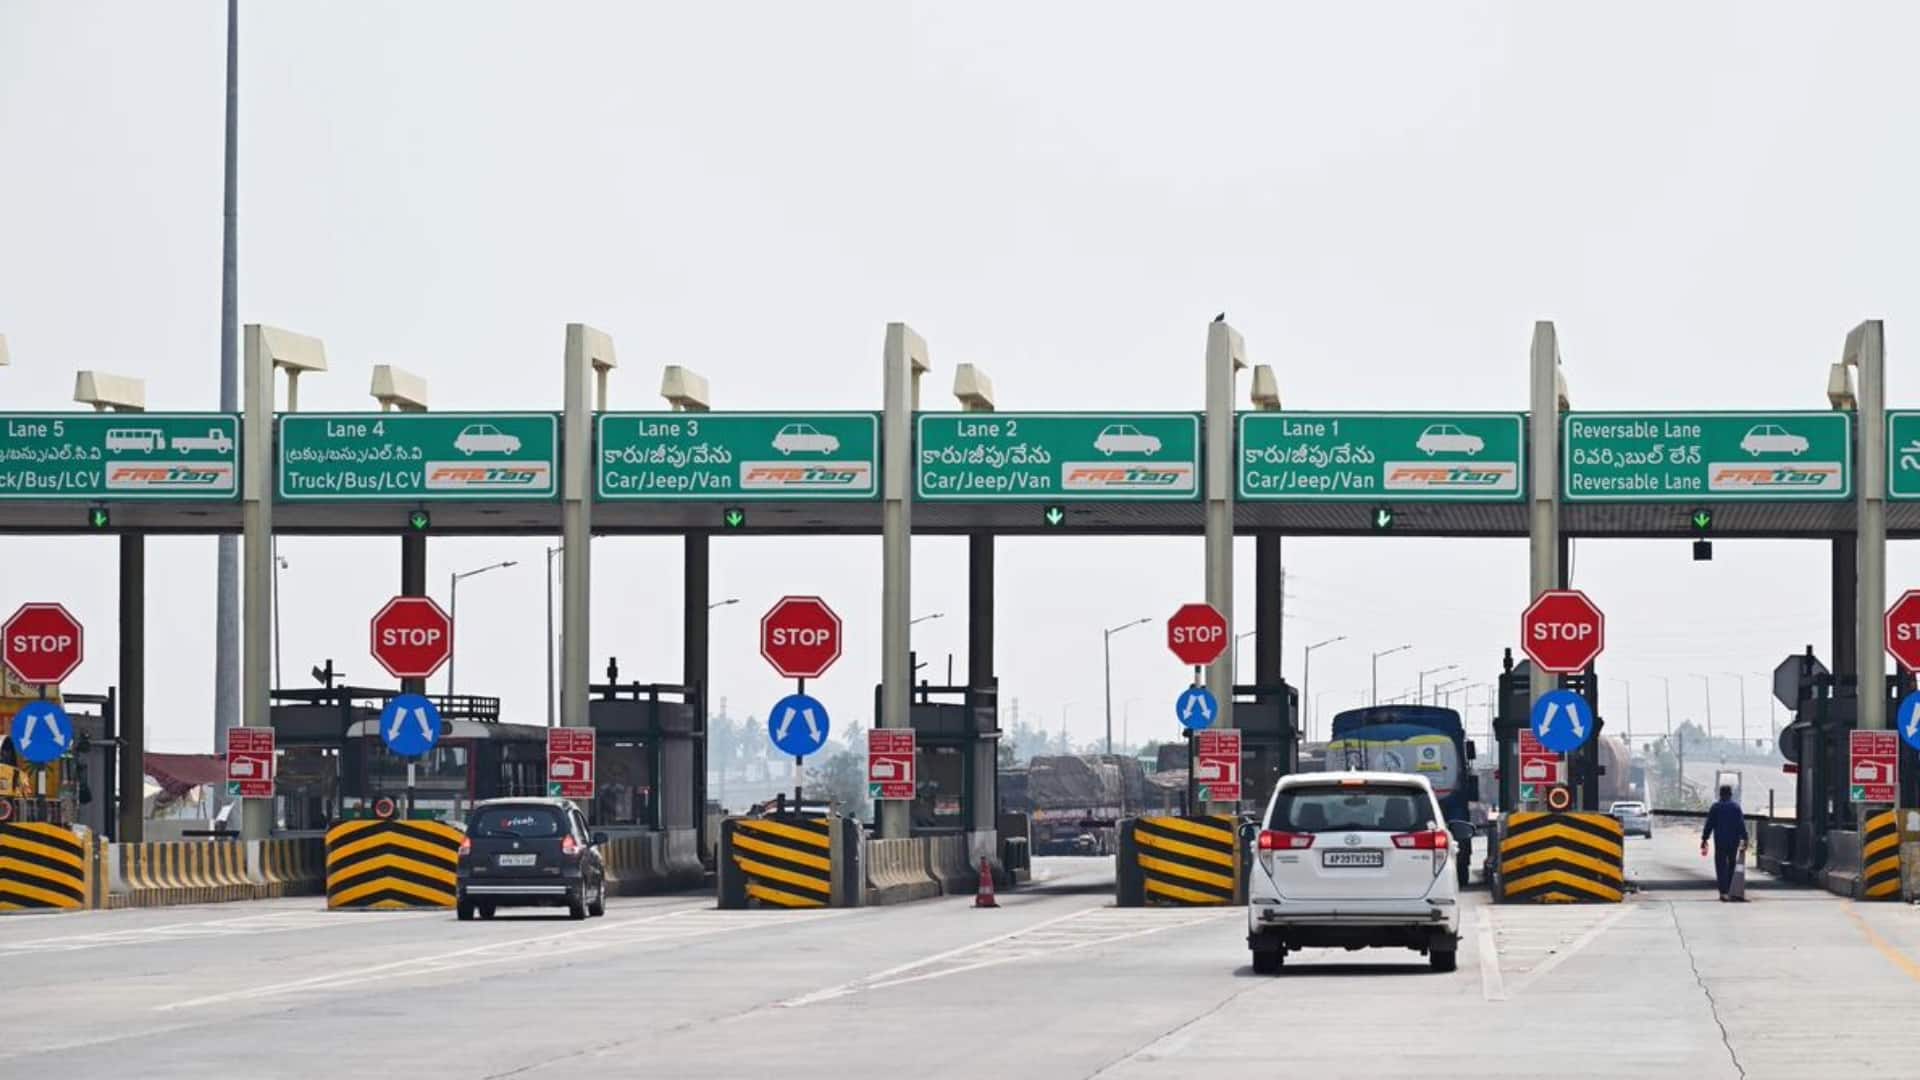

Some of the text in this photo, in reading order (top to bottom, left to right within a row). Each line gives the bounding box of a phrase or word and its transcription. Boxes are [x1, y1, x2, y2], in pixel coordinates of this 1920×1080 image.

[8, 420, 64, 437] Lane 5
[327, 420, 385, 437] Lane 4
[639, 420, 699, 436] Lane 3
[957, 420, 1017, 437] Lane 2
[1283, 420, 1339, 437] Lane 1
[1572, 421, 1701, 438] Reversable Lane
[289, 471, 421, 490] Truck/Bus/LCV
[606, 471, 732, 490] Car/Jeep/Van
[923, 471, 1050, 491] Car/Jeep/Van
[1246, 471, 1374, 490] Car/Jeep/Van
[1572, 472, 1701, 489] Reversable Lane
[383, 629, 441, 646] STOP
[772, 628, 830, 646] STOP
[1173, 626, 1223, 643] STOP
[1533, 623, 1593, 641] STOP
[13, 635, 72, 653] STOP
